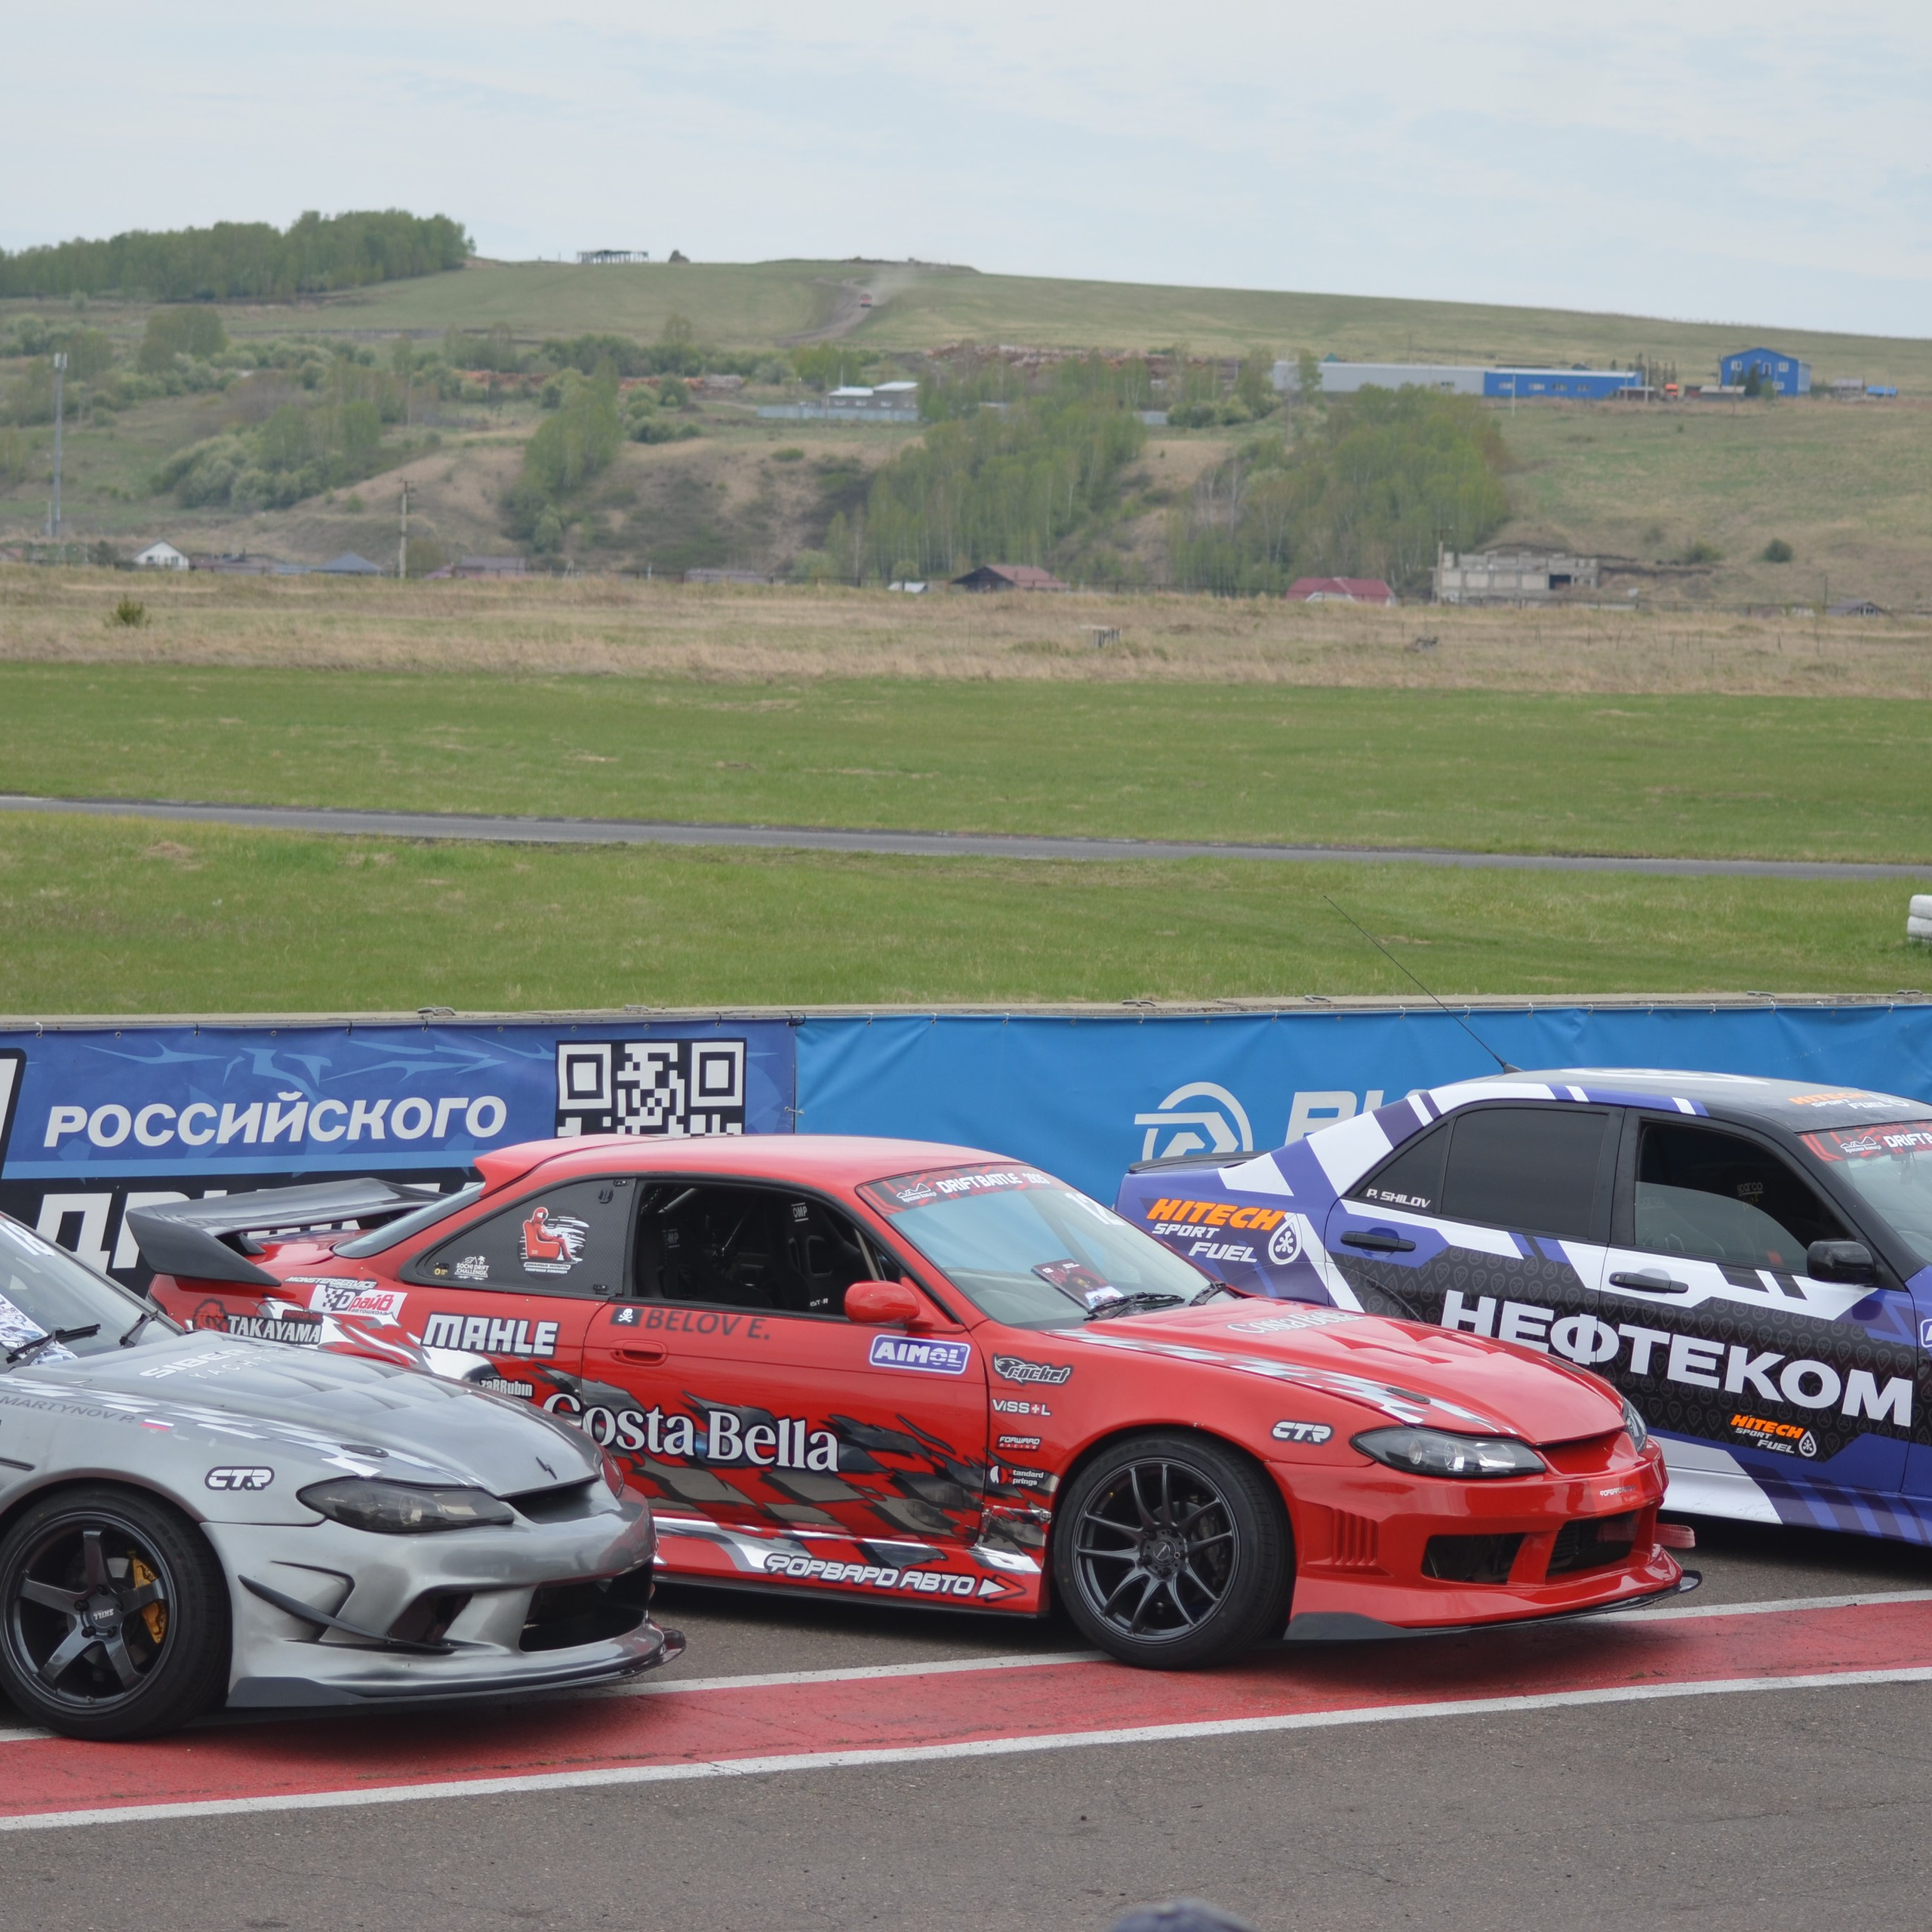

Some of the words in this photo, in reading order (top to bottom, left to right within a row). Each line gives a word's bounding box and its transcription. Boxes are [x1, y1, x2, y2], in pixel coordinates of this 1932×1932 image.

[43, 1091, 507, 1148] РОССИЙСКОГО
[1883, 1134, 1926, 1148] DRIFT
[935, 1176, 981, 1194] DRIFT
[974, 1173, 1023, 1187] BATTLE
[1065, 1192, 1126, 1226] 12
[1366, 1188, 1378, 1199] P.
[1380, 1191, 1431, 1208] SHILOV
[792, 1205, 808, 1219] OMP
[1146, 1198, 1286, 1230] HITECH
[1152, 1223, 1220, 1238] SPORT
[1188, 1241, 1258, 1263] FUEL
[456, 1268, 488, 1276] CHALLENGE
[228, 1315, 321, 1343] TAKAYAMA
[423, 1314, 558, 1355] MAHLE
[645, 1309, 743, 1336] BELOV
[746, 1317, 771, 1340] E.
[874, 1342, 962, 1367] AIMOL
[1441, 1289, 1913, 1427] НЕФТЕКОМ
[0, 1396, 117, 1419] MARTYNOV
[118, 1414, 137, 1424] P.
[1730, 1414, 1804, 1439] HITECH
[1735, 1427, 1772, 1439] SPORT
[708, 1411, 839, 1472] Bella
[998, 1435, 1041, 1444] FORWARD
[1757, 1439, 1795, 1454] FUEL
[900, 1571, 976, 1595] АВТО
